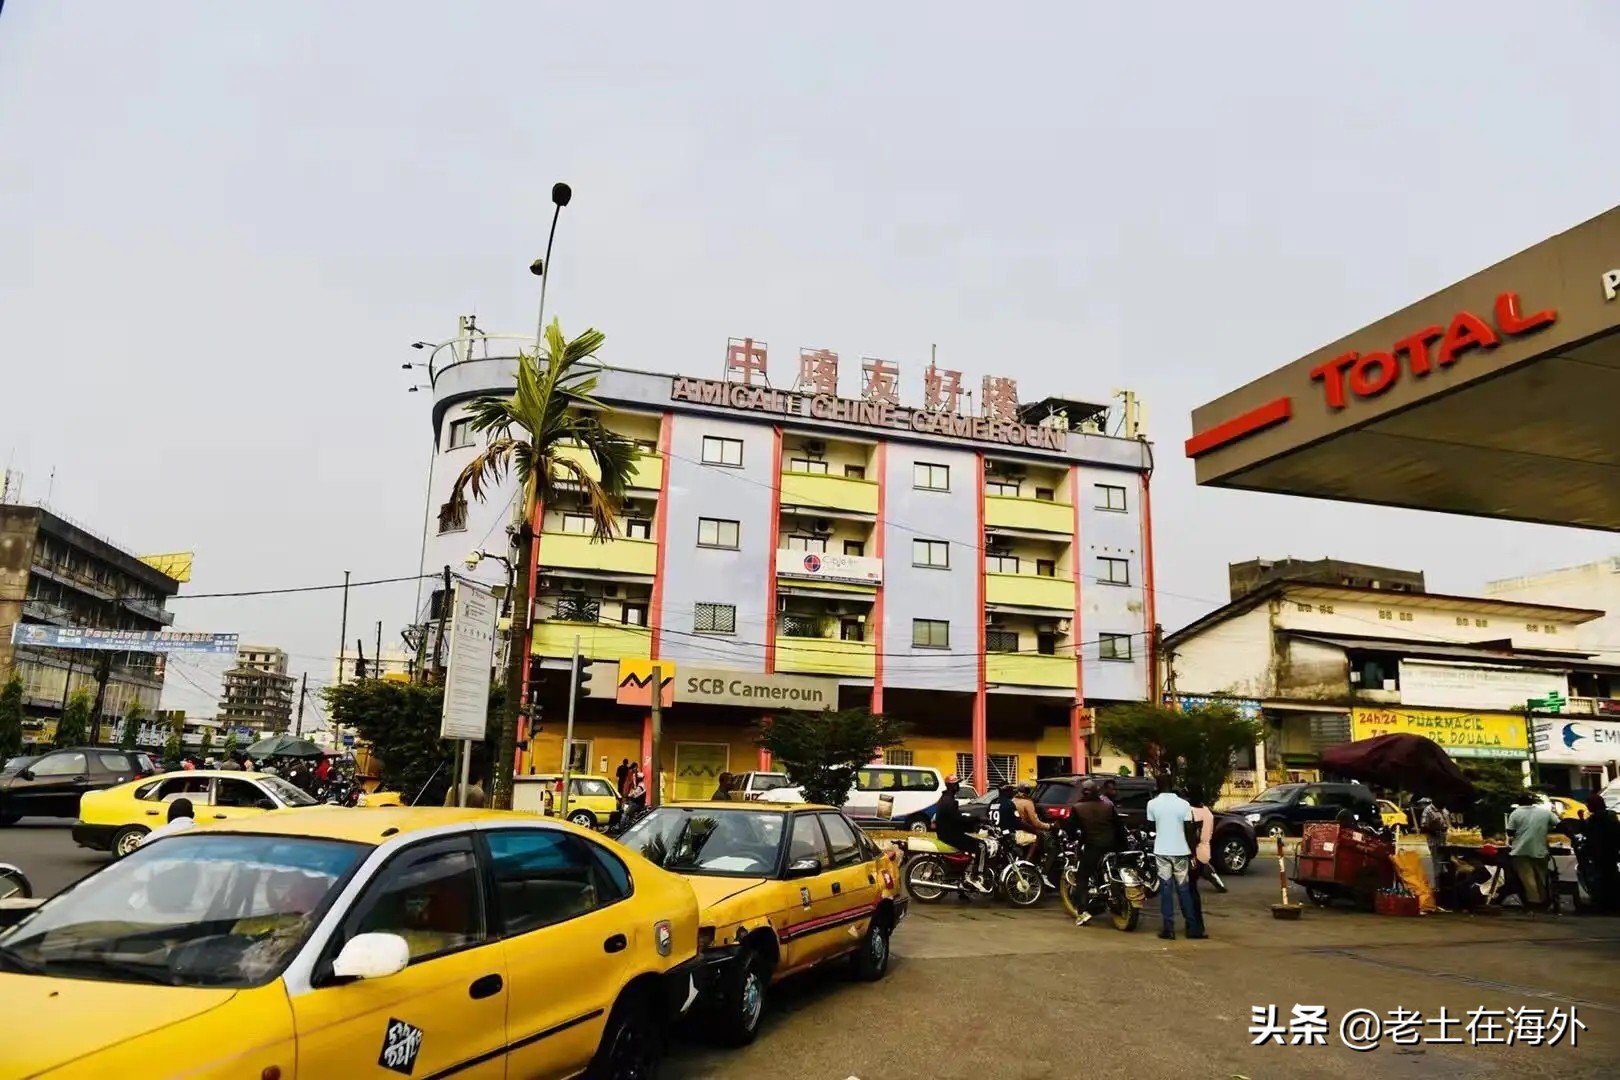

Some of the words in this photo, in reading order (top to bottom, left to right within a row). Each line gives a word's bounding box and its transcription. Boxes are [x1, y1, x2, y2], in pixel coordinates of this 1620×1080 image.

[1311, 290, 1557, 409] TOTAL
[672, 377, 802, 414] AMICALE
[687, 677, 724, 695] SCB
[729, 680, 823, 702] Cameroun
[1407, 714, 1484, 730] PHARMACIE
[1428, 731, 1445, 744] DE
[1451, 731, 1501, 746] DOUALA
[988, 810, 1000, 825] 19
